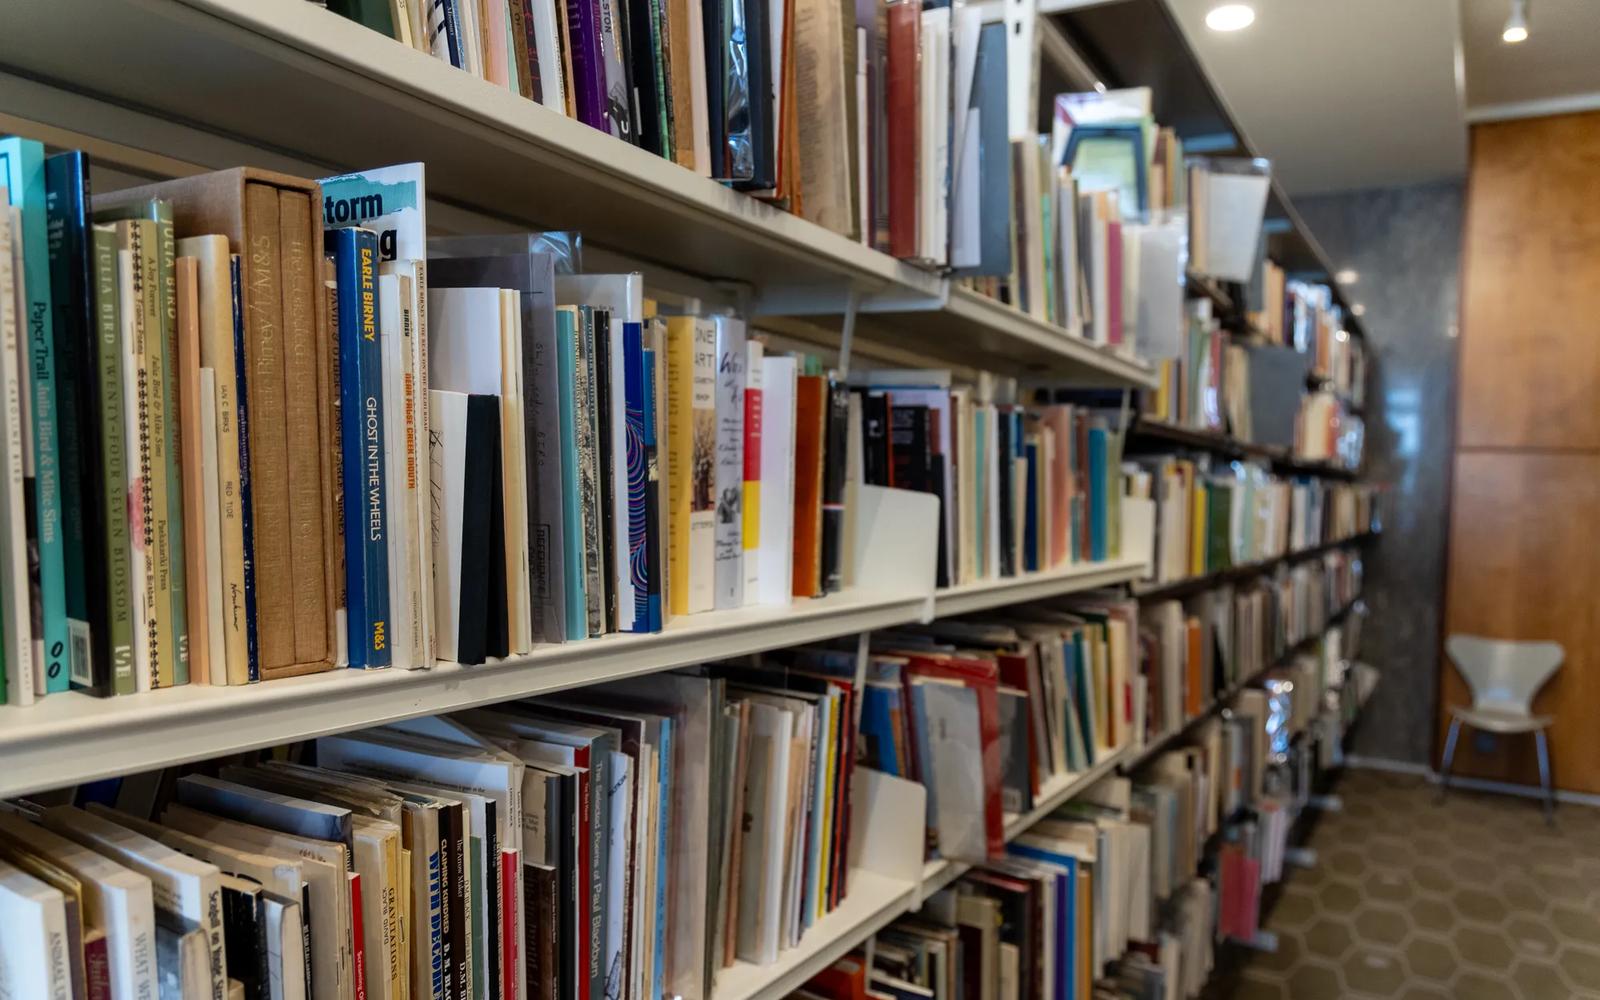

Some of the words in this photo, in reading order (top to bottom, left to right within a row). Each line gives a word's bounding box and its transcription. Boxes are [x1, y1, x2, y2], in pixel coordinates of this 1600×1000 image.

[602, 0, 612, 33] STON
[322, 193, 383, 223] torm
[161, 218, 176, 269] JULIA
[97, 245, 113, 295] JULIA
[361, 248, 374, 289] EARLE
[149, 283, 157, 318] Forever
[165, 277, 176, 320] BIRD
[31, 301, 49, 342] Paper
[103, 303, 116, 344] BIRD
[363, 291, 376, 342] BIRNEY
[35, 346, 50, 381] Trail
[151, 354, 161, 378] Julia
[37, 383, 52, 416] Julia
[153, 379, 162, 399] Bird
[105, 353, 122, 479] TWENTY-FOUR
[154, 412, 163, 435] Mike
[222, 410, 230, 433] BIRKS
[366, 397, 378, 443] GHOST
[39, 421, 54, 454] Bird
[155, 437, 164, 459] Sims
[368, 445, 379, 460] IN
[406, 427, 415, 455] CREEK
[41, 470, 54, 506] Mike
[225, 481, 233, 497] RED
[369, 460, 380, 487] THE
[407, 456, 416, 490] MOUTH
[44, 508, 57, 544] Sims
[112, 488, 126, 538] SEVEN
[226, 501, 234, 519] TIDE
[370, 487, 382, 541] WHEELS
[114, 548, 127, 623] BLOSSOM
[373, 620, 386, 651] M&S
[595, 760, 603, 782] The
[594, 784, 603, 829] Selected
[441, 838, 449, 887] CLAIMING
[593, 830, 602, 868] Poems
[429, 850, 441, 911] WITH
[593, 869, 602, 881] of
[442, 889, 450, 934] KINDRED
[592, 882, 603, 912] Paul
[388, 888, 398, 981] GRAVITATIONS
[443, 943, 451, 956] D.
[591, 914, 602, 978] Blackburn
[135, 932, 149, 976] WHAT
[356, 950, 364, 992] Screaming
[444, 958, 451, 972] M.
